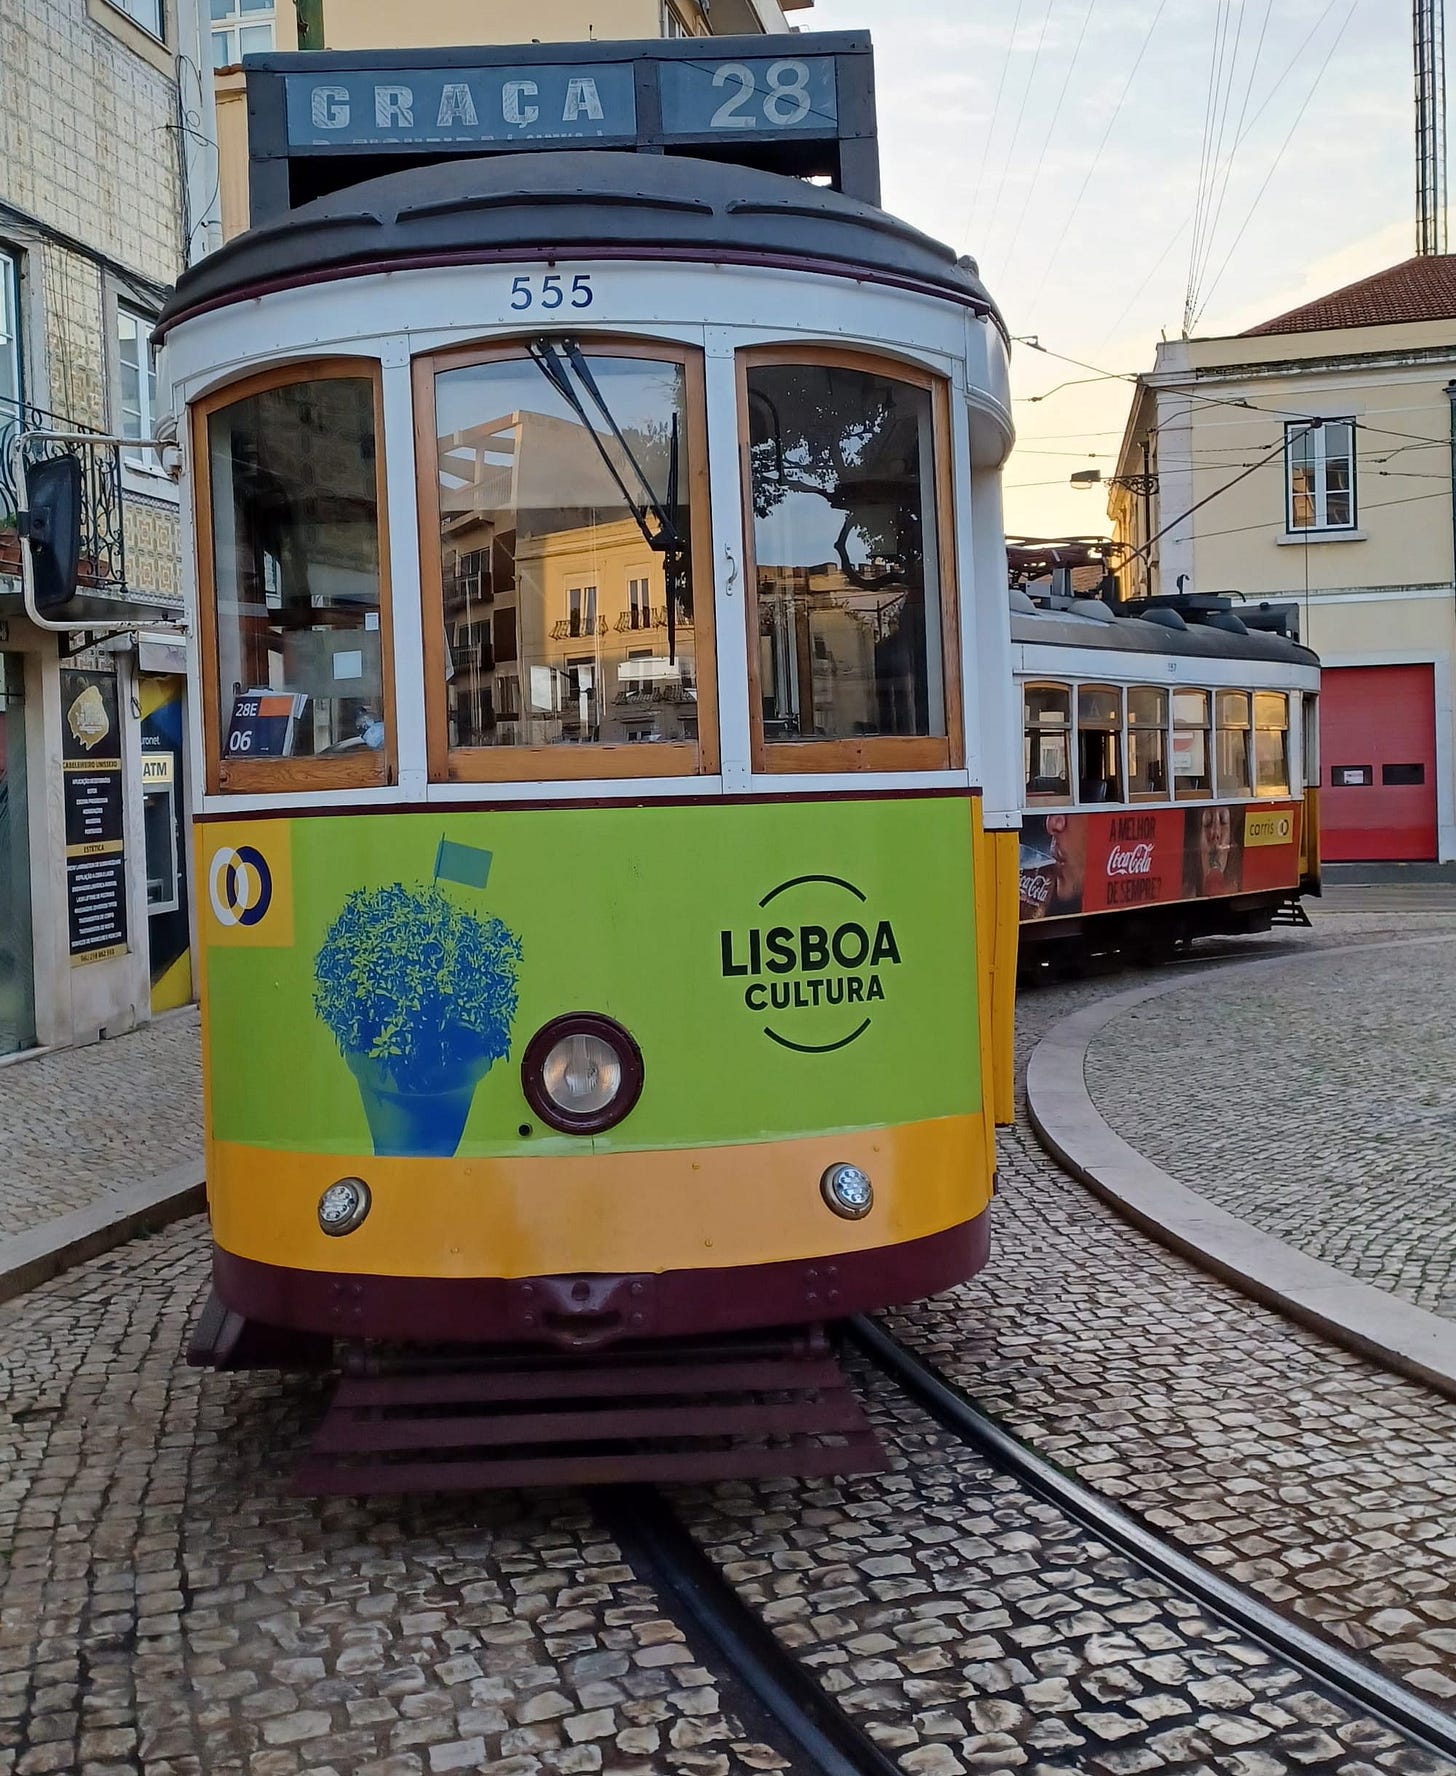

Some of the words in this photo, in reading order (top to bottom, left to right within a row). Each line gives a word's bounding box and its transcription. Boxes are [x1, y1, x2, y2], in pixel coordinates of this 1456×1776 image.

[311, 78, 606, 129] GRAÇA
[710, 60, 811, 128] 28
[511, 274, 593, 310] 555
[235, 703, 258, 717] 28E
[230, 730, 253, 751] 06
[143, 762, 167, 776] ATM
[1250, 818, 1274, 836] carris
[720, 920, 902, 977] LISBOA
[744, 974, 886, 1011] CULTURA
